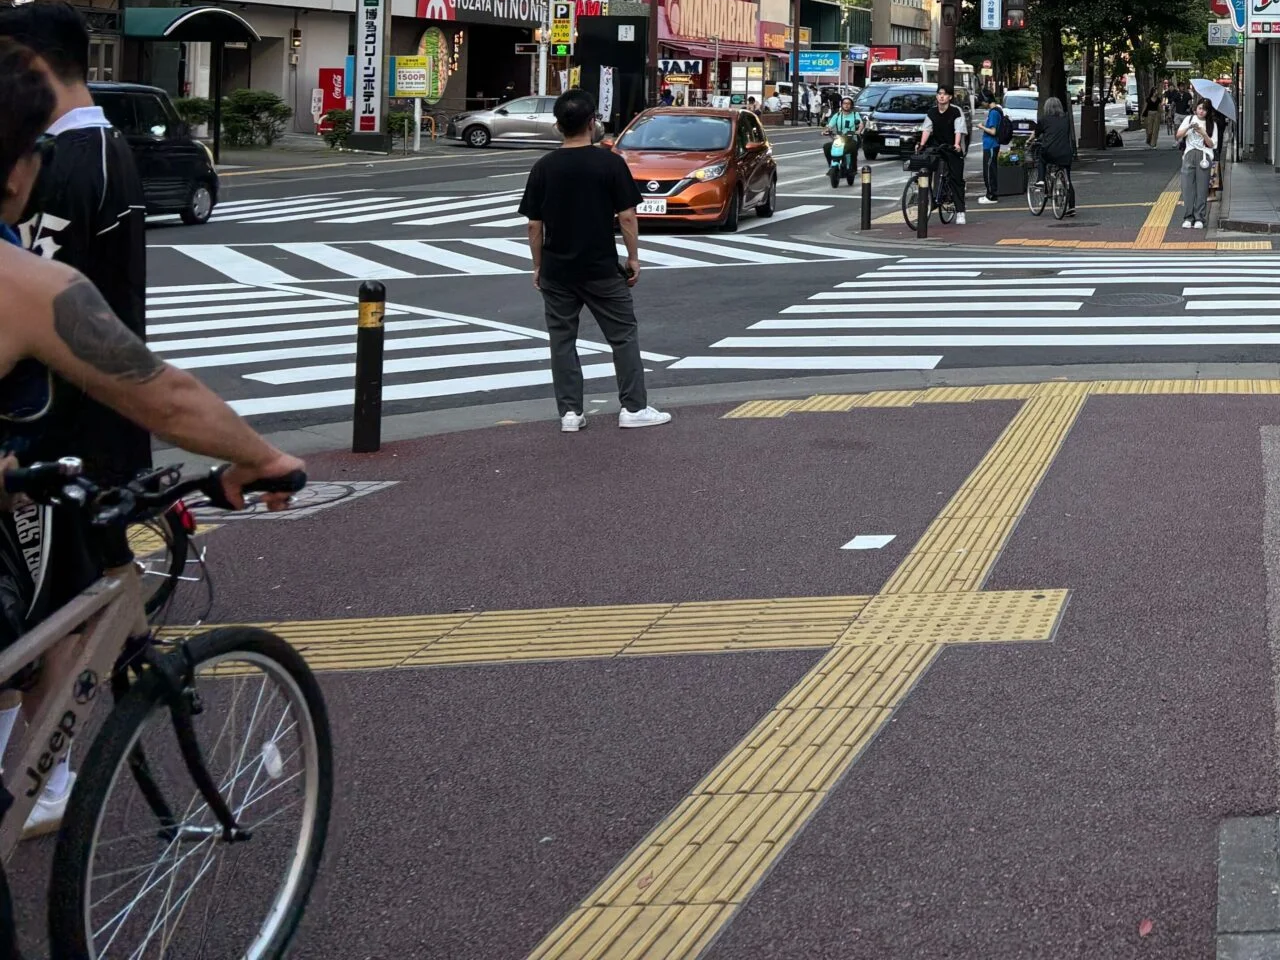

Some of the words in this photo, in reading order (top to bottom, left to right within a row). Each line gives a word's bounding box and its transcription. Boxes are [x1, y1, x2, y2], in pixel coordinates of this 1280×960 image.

[557, 5, 567, 18] P
[362, 8, 378, 114] 博多グリーンホテル
[658, 61, 700, 74] JAM
[24, 709, 77, 797] Jeep
